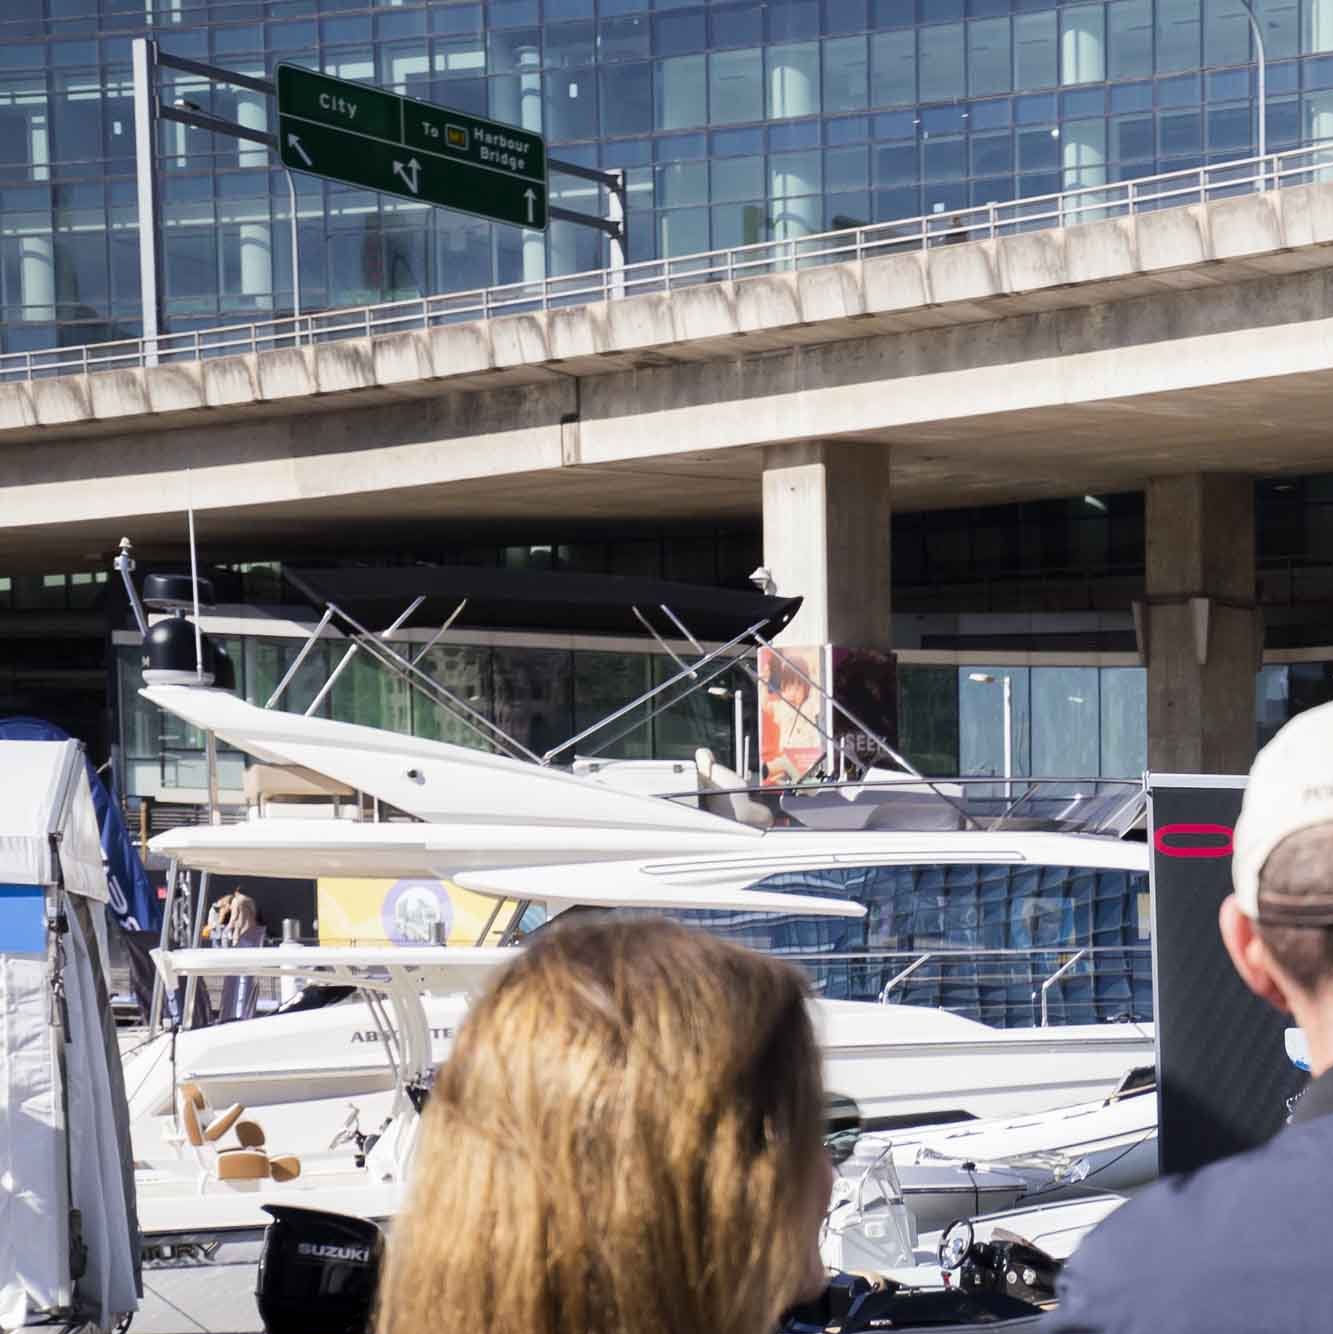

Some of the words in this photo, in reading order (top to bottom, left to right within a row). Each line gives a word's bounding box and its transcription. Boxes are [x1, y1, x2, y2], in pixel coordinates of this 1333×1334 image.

[319, 93, 358, 119] City
[421, 121, 439, 138] To
[474, 127, 531, 154] Harbour
[479, 146, 526, 171] Bridge
[297, 1242, 370, 1263] SUZUKI
